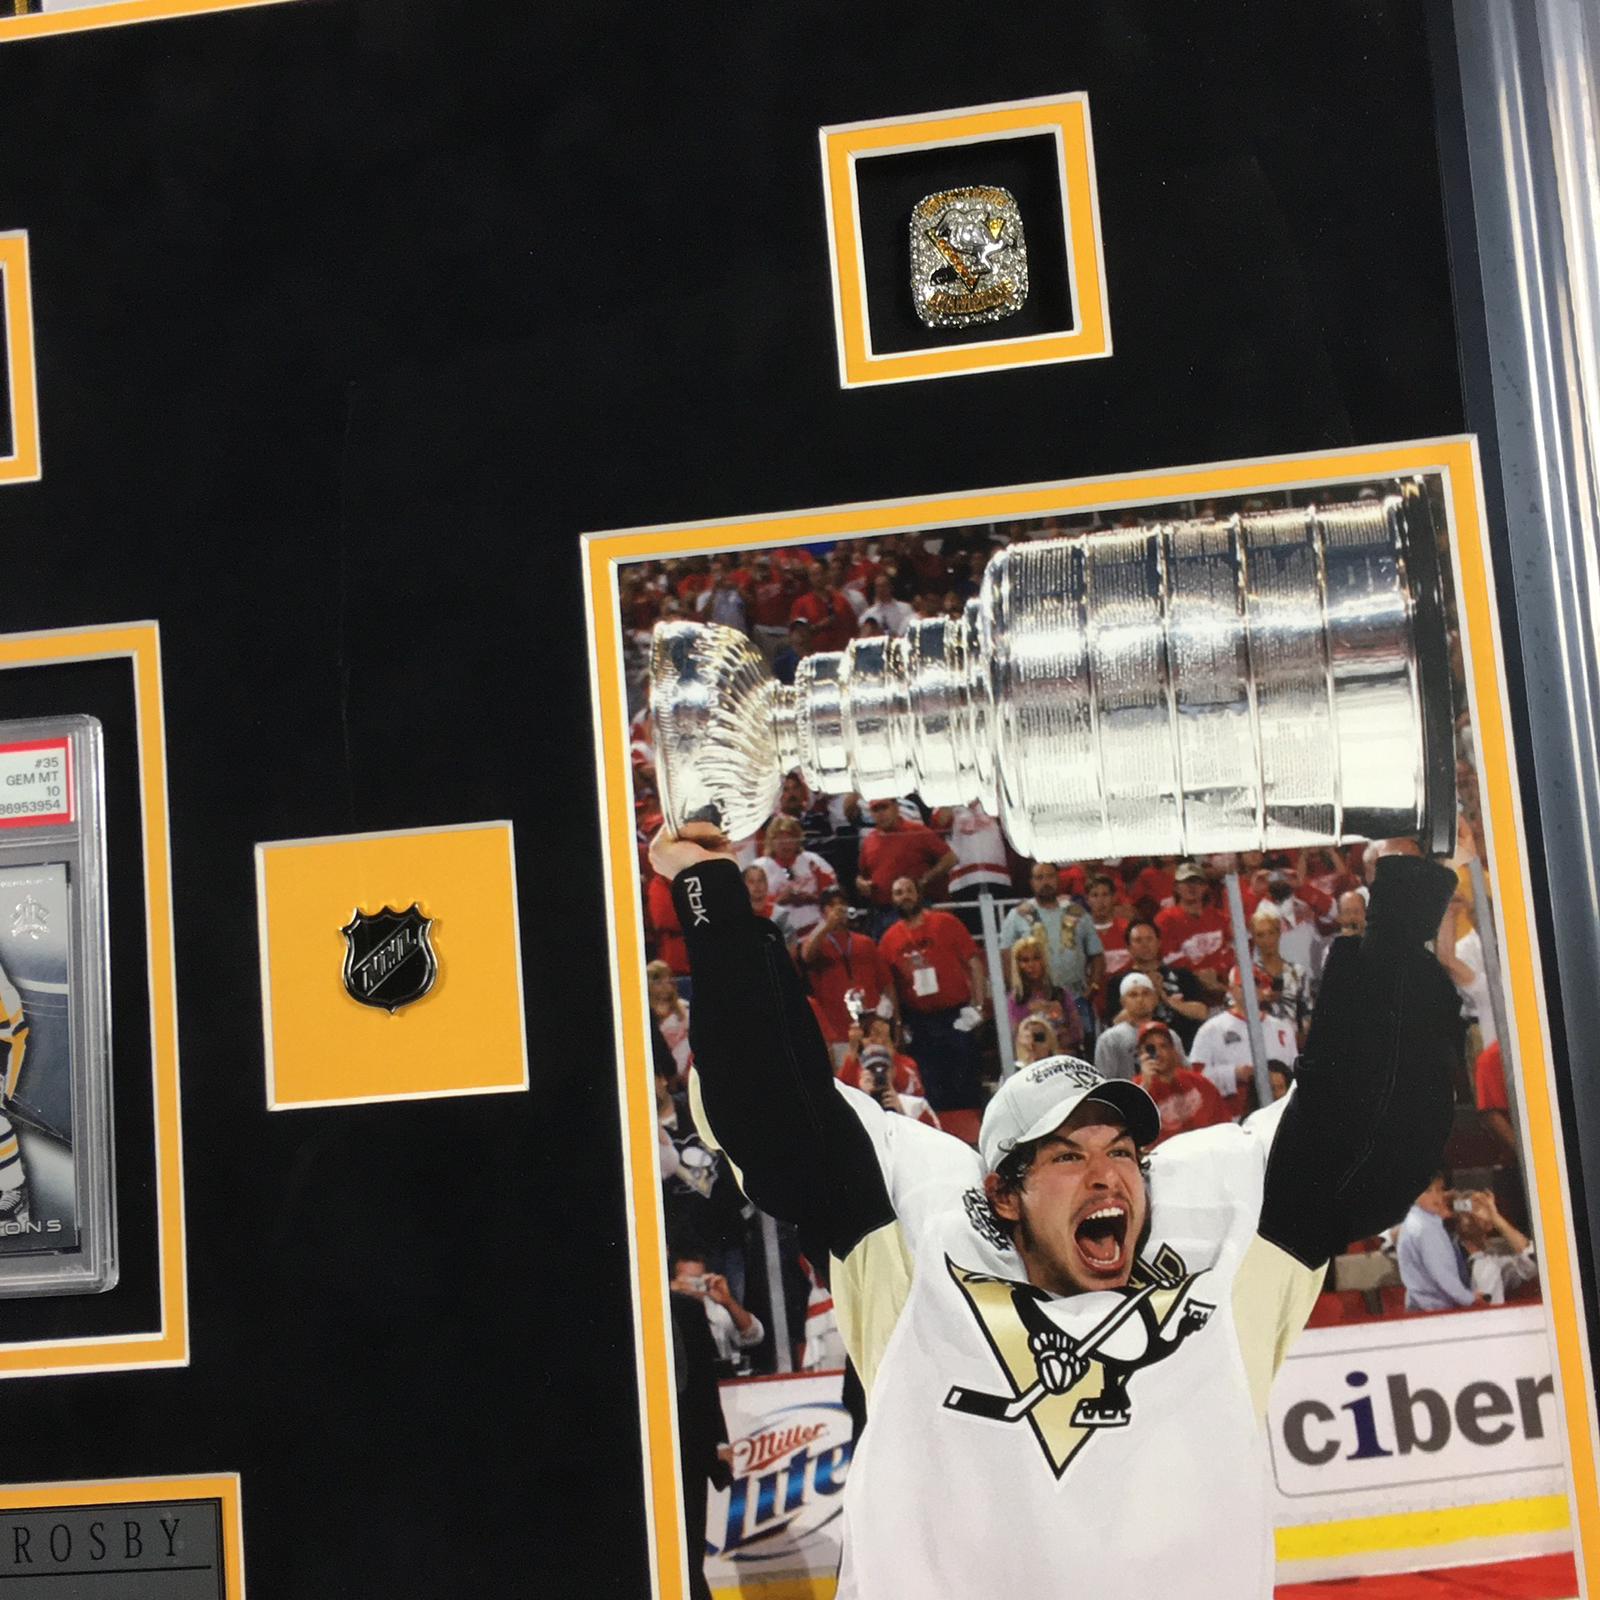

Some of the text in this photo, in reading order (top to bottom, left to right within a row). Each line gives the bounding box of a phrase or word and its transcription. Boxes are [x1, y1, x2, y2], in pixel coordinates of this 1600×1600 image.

[6, 770, 58, 786] GEM MT
[34, 756, 59, 769] #35
[46, 785, 61, 797] 10
[1282, 1370, 1555, 1466] ciber
[733, 1422, 827, 1471] Miller
[722, 1441, 855, 1552] Lite
[12, 1518, 181, 1564] ROSBY
